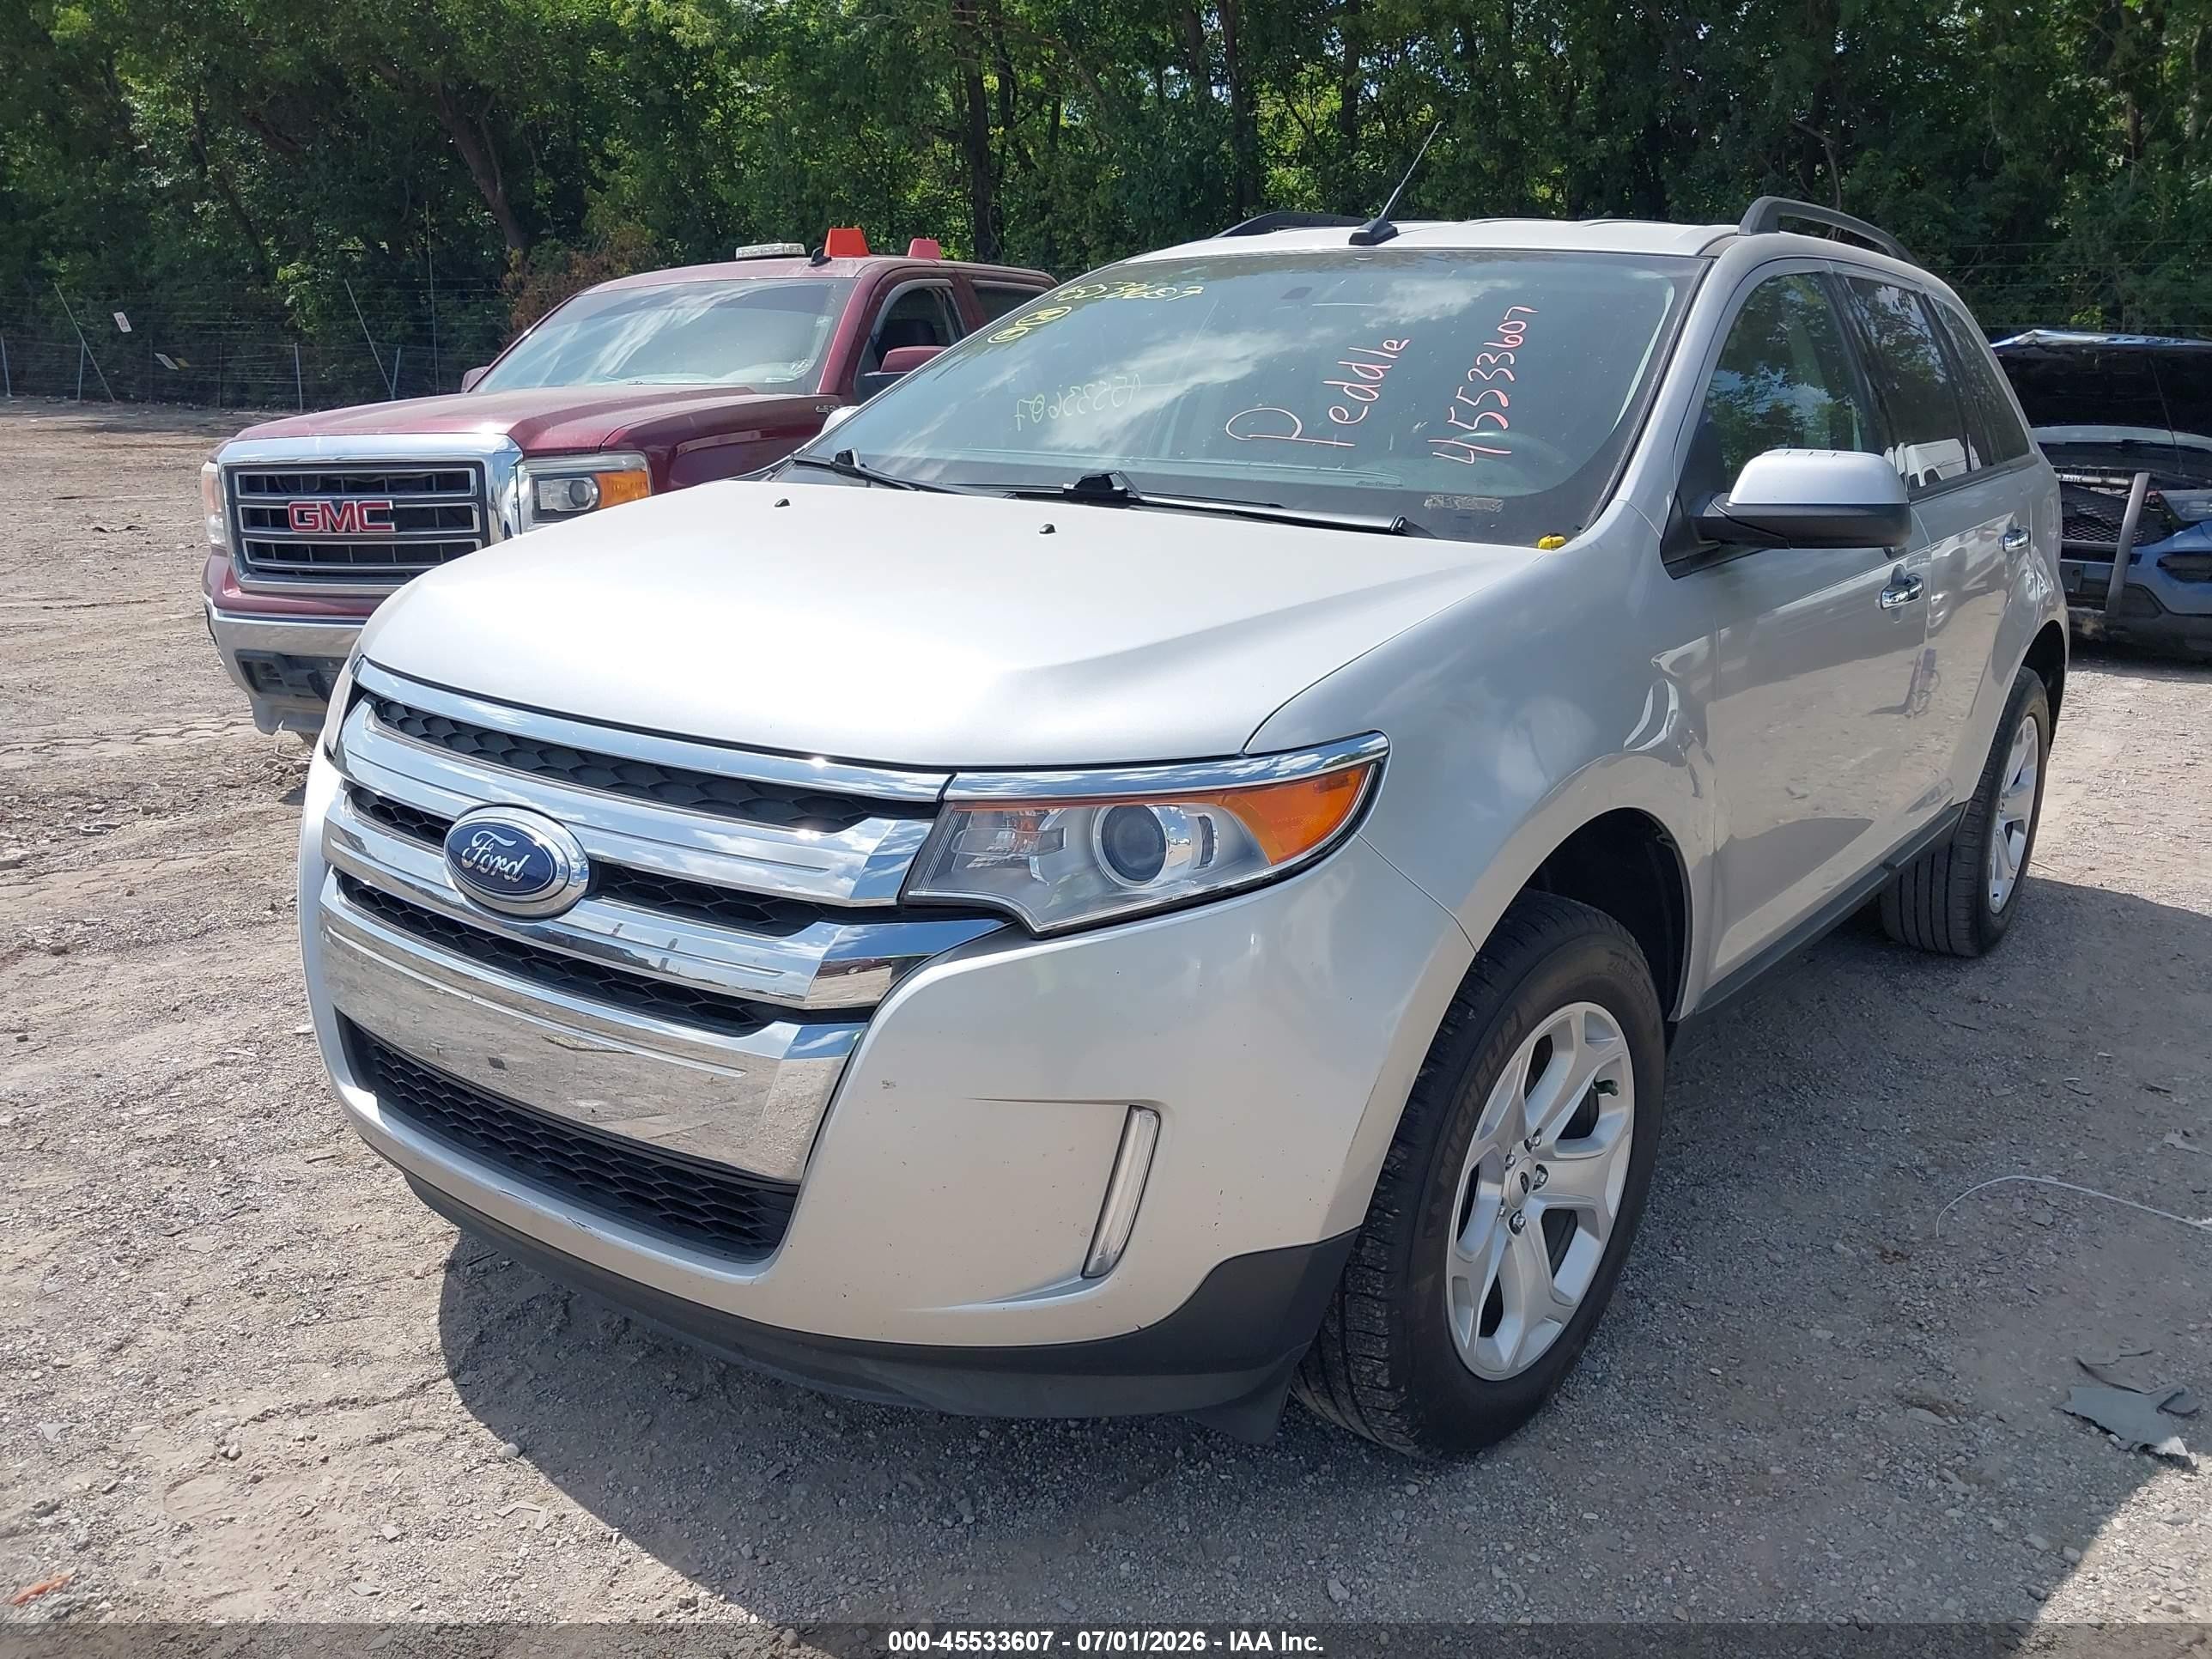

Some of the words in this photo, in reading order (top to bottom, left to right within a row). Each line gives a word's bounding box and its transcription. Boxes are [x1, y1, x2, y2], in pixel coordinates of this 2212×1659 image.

[1224, 337, 1412, 449] Peddle
[1428, 305, 1540, 465] 45533607
[289, 501, 396, 533] GMC
[461, 830, 532, 883] Ford
